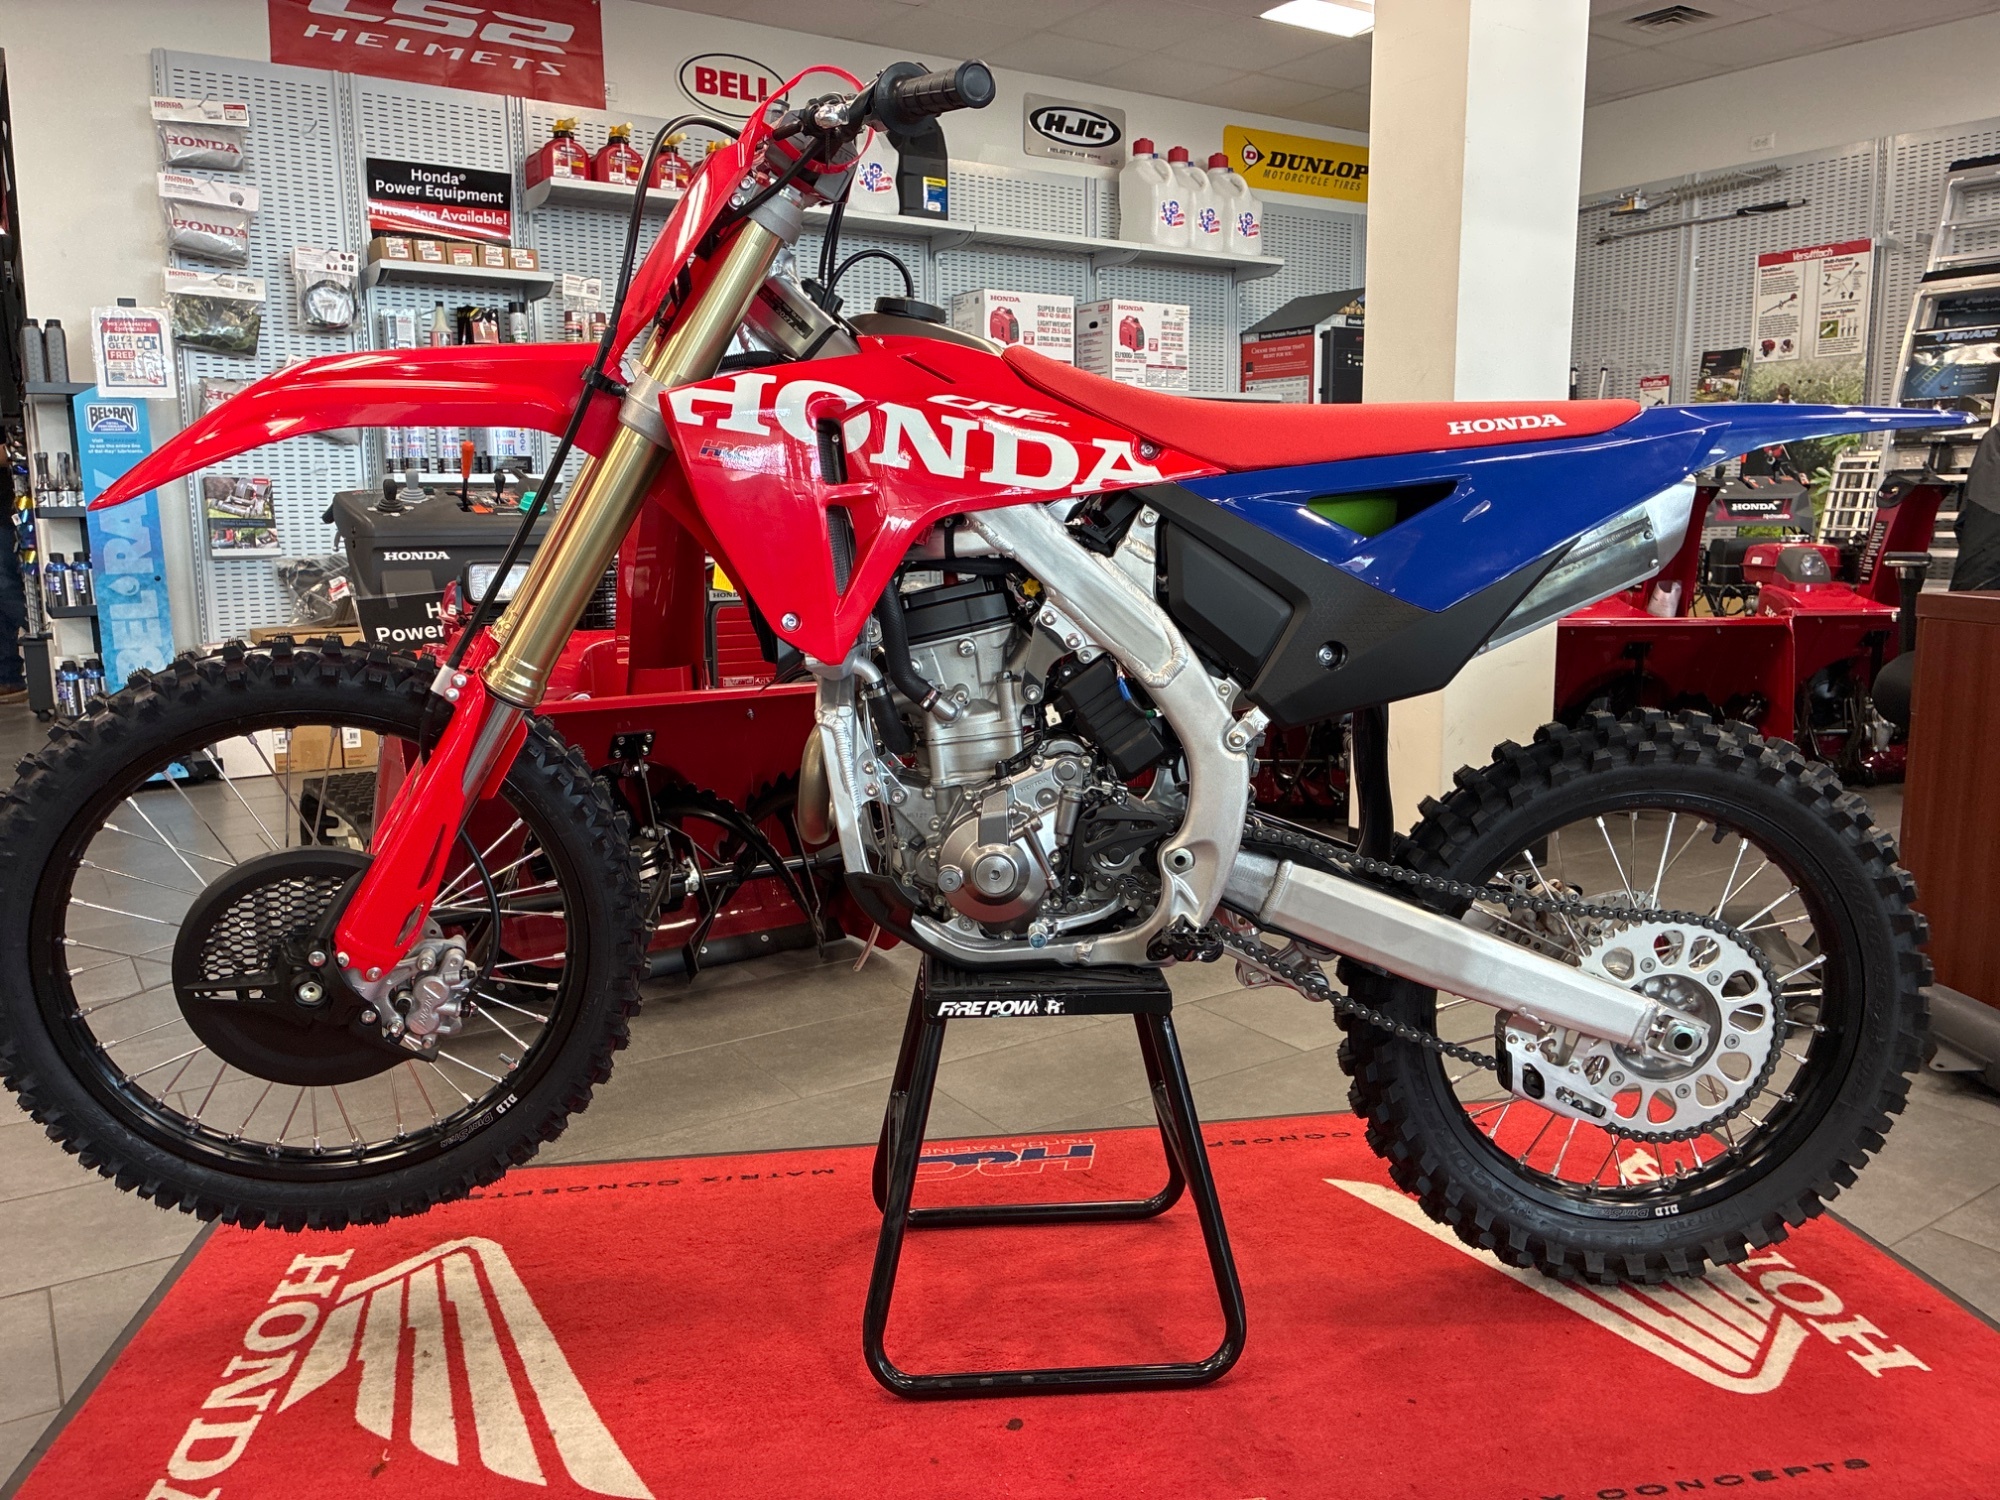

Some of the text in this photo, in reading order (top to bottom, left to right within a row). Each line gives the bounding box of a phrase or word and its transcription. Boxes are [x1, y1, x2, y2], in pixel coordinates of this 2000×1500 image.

[308, 0, 575, 55] LS2
[303, 24, 567, 76] HELMETS
[695, 66, 768, 103] BELL
[1043, 113, 1107, 140] HJC
[165, 137, 240, 154] HONDA
[1266, 151, 1369, 180] DUNLOP
[1263, 169, 1361, 192] MOTORCYCLE TIRES
[375, 180, 504, 204] Power Equipment
[440, 207, 508, 226] Available!
[173, 218, 248, 239] HONDA
[168, 270, 198, 278] HONDA
[990, 295, 1021, 303] HONDA
[1117, 304, 1144, 312] HONDA
[110, 351, 134, 359] FREE
[926, 394, 1059, 419] CRF
[675, 372, 1162, 494] HONDA
[1447, 414, 1567, 435] HONDA
[407, 448, 424, 458] FUEL
[497, 443, 517, 456] FUEL
[1731, 503, 1777, 511] HONDA
[384, 551, 450, 561] HONDA
[713, 591, 740, 599] HOND
[67, 686, 75, 709] FOAM
[984, 1000, 1064, 1017] POWR
[1207, 1131, 1351, 1148] CONCEP
[701, 1168, 835, 1184] MATRIX
[140, 1248, 356, 1500] HOND
[1597, 1458, 1871, 1500] CONCEPTS
